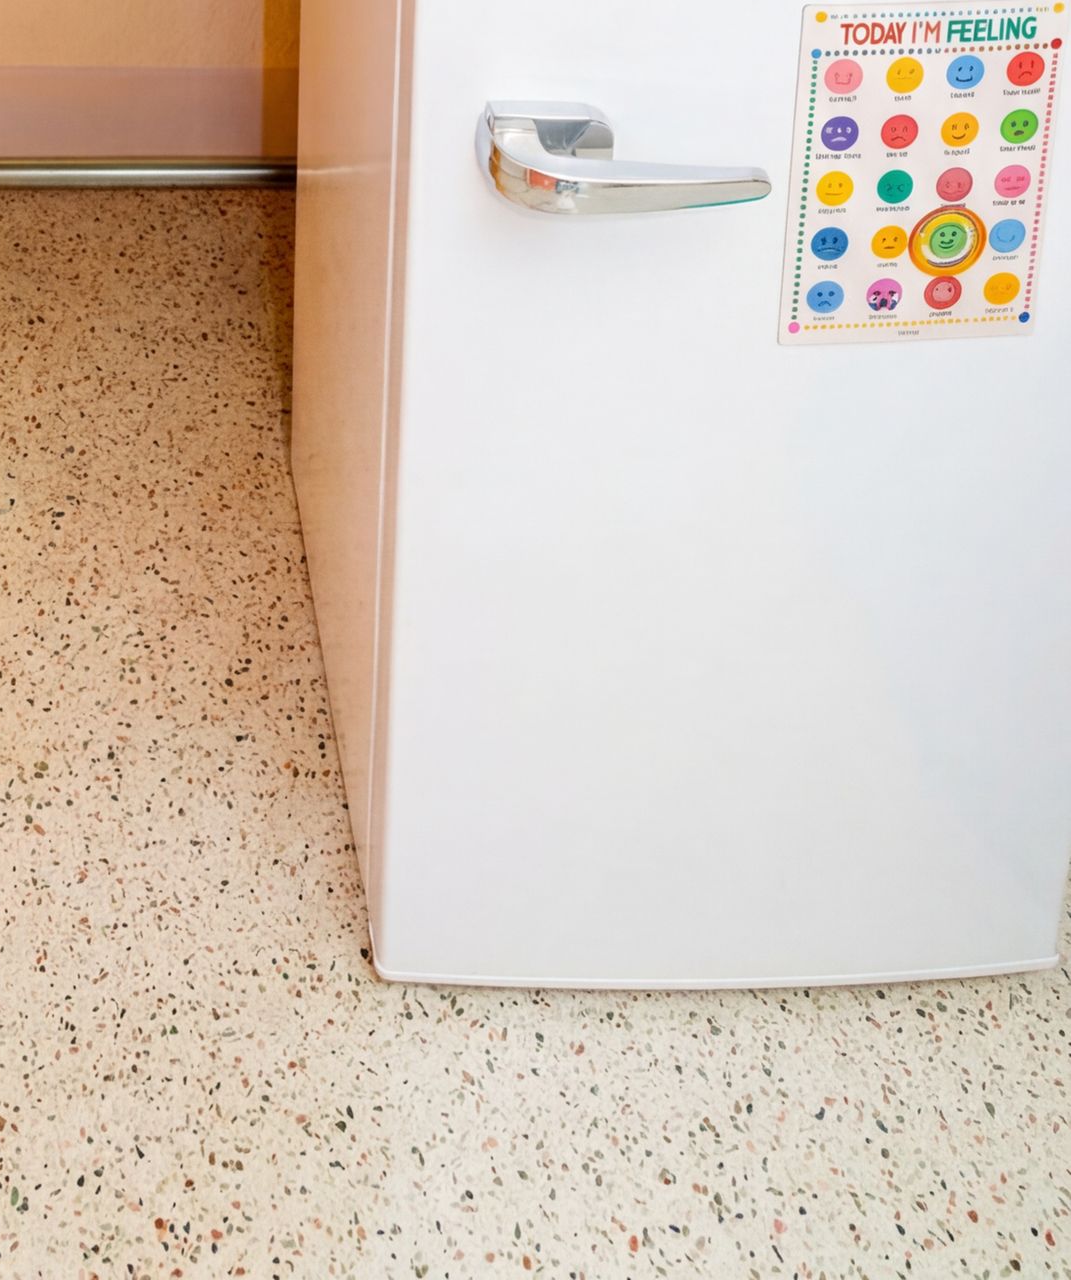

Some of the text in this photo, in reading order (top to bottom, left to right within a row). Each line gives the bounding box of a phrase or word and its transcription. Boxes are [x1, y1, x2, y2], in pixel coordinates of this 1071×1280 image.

[840, 16, 1038, 46] TODAY I'M FEELING
